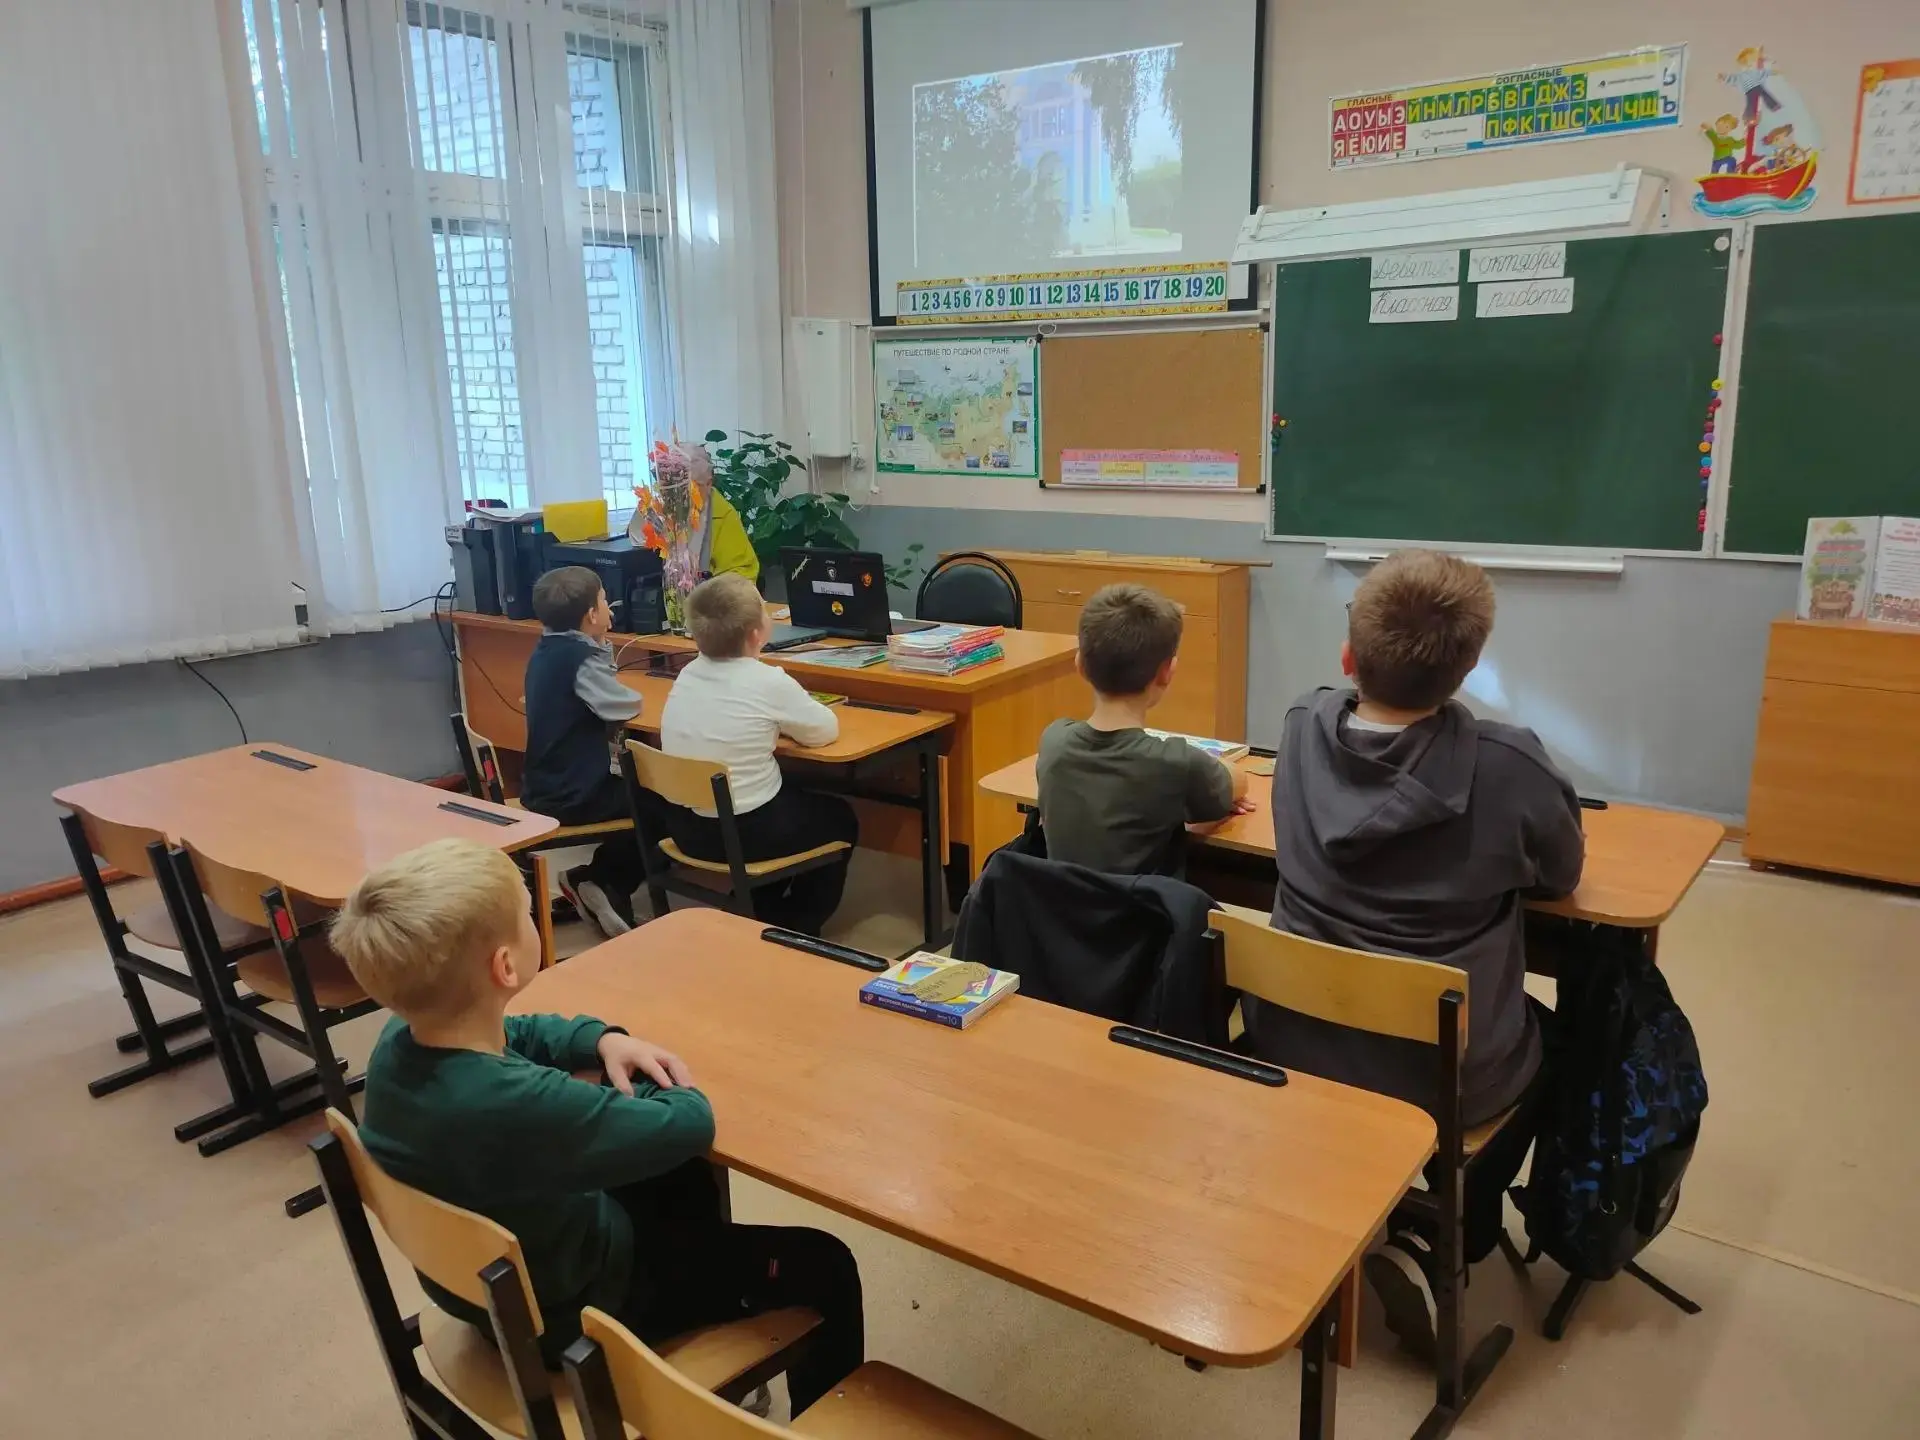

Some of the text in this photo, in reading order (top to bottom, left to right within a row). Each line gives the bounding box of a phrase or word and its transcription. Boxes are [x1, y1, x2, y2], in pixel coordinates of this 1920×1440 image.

[1495, 67, 1562, 85] СОГЛАСНЫЕ
[1347, 93, 1393, 106] ГЛАСНЫЕ
[912, 275, 1225, 311] 1 2 3 4 5 6 7 8 9 10 11 12 13 14 15 16 17 18 19 20
[893, 347, 1010, 357] ПУТЕШЕСТВИЕ ПО РОДНОЙ СТРАНЕ
